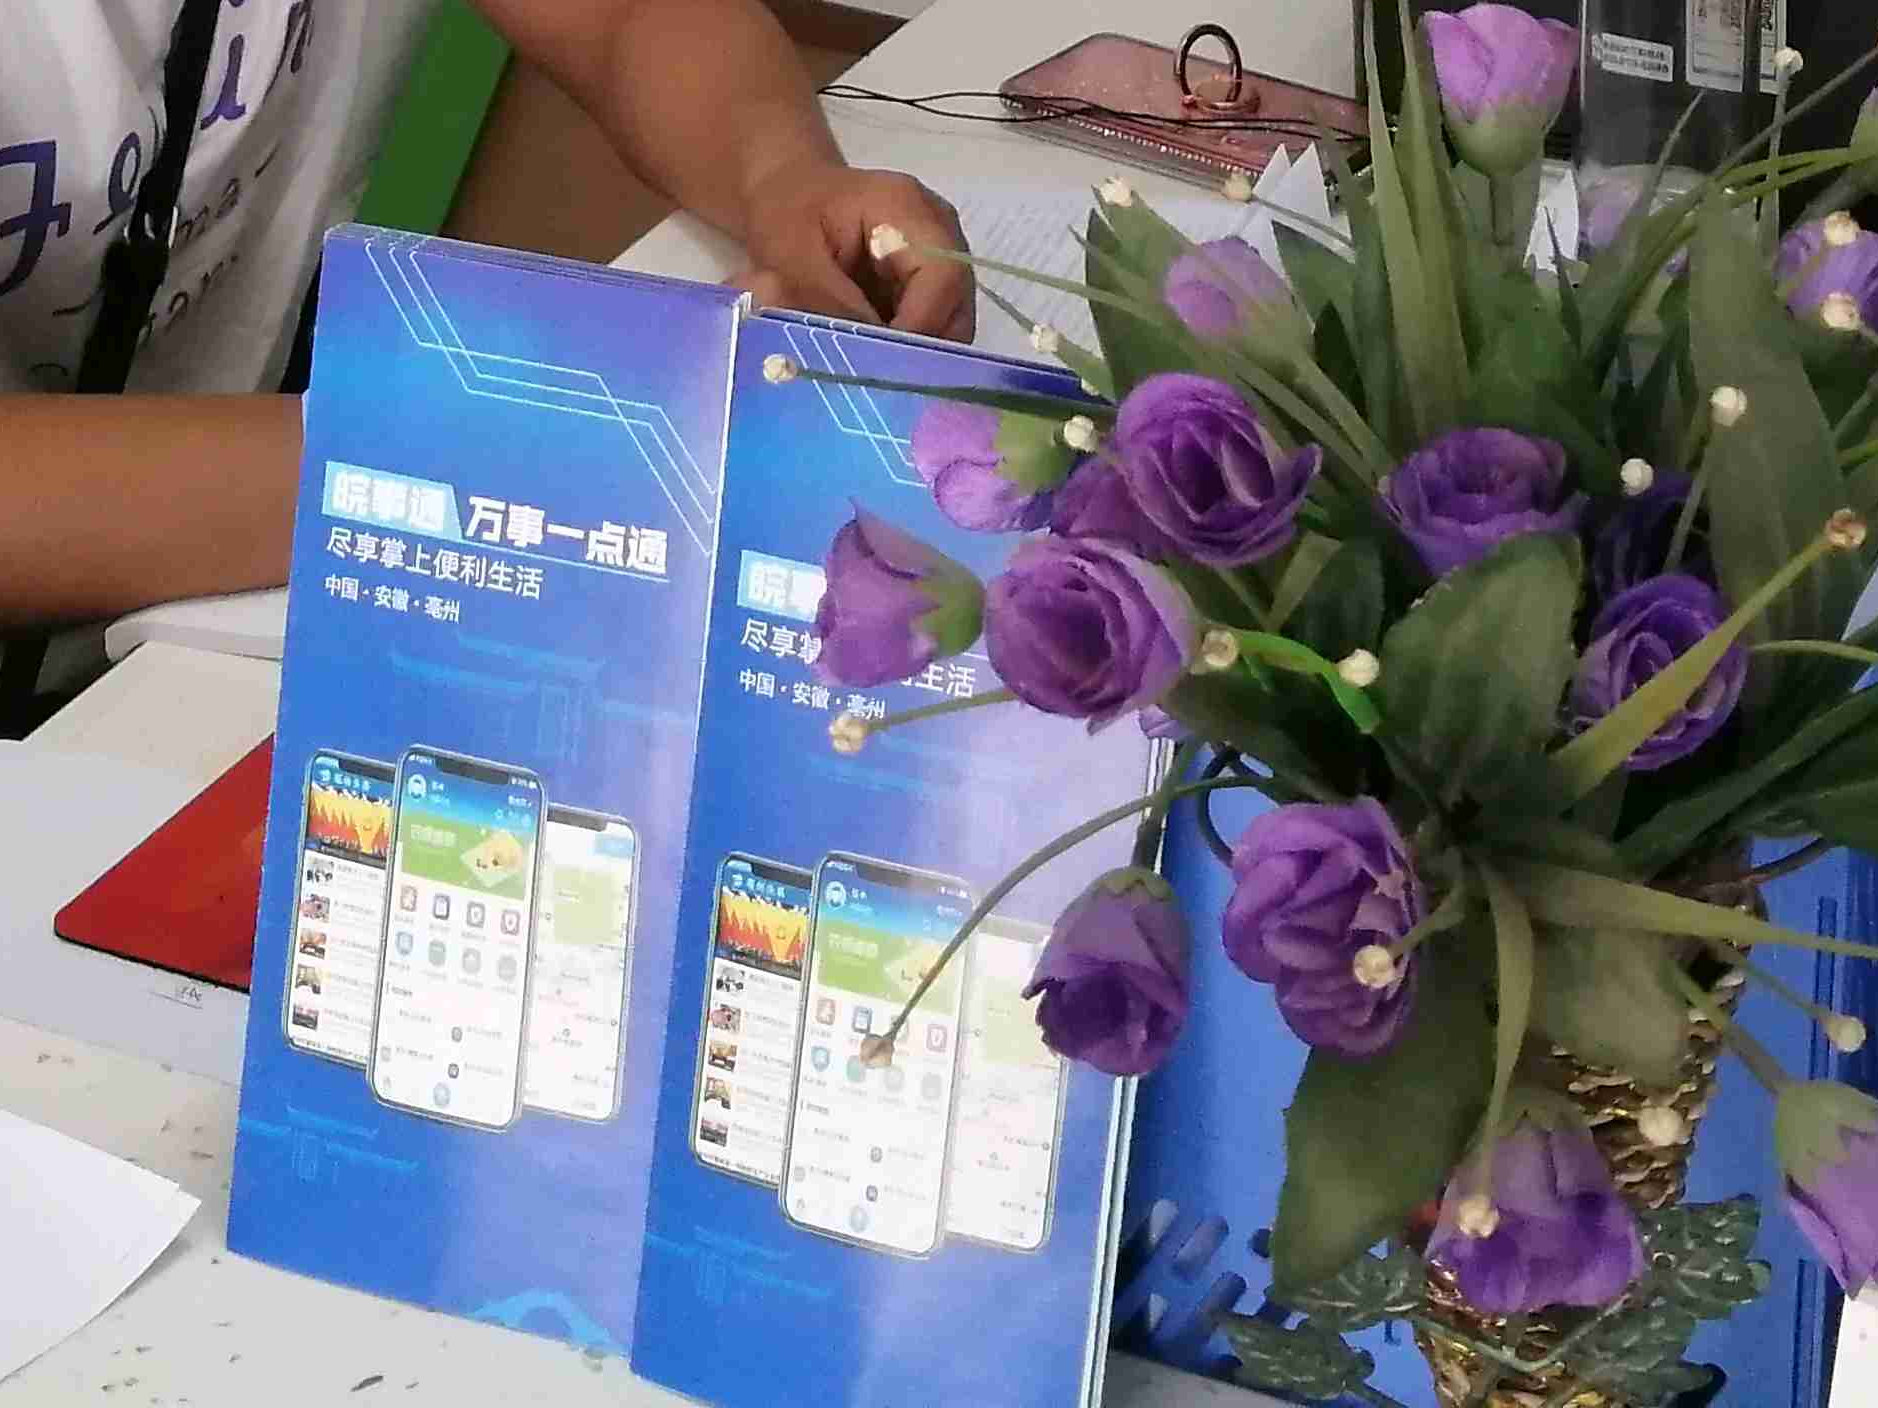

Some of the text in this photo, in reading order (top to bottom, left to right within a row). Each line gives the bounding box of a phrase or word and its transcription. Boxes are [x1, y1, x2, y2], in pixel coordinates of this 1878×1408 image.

[327, 527, 544, 600] 尽享掌上便利生活
[464, 496, 668, 574] 万事一点通
